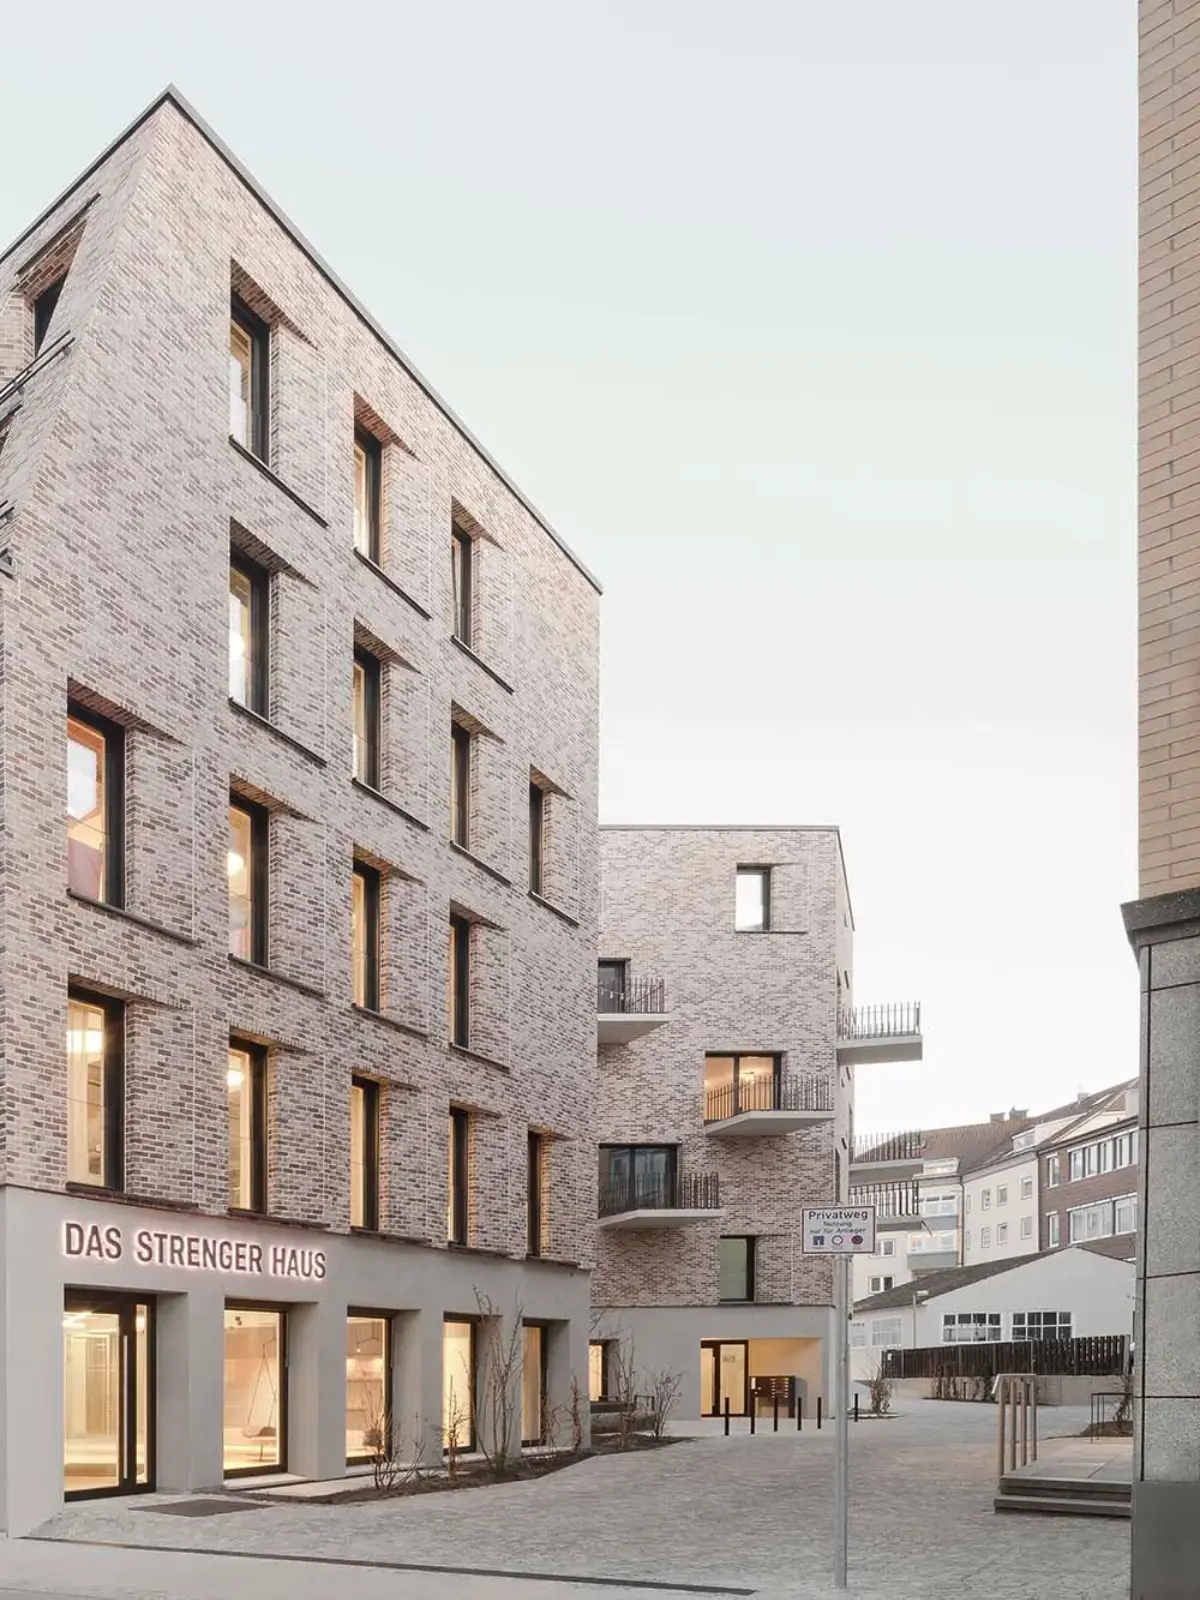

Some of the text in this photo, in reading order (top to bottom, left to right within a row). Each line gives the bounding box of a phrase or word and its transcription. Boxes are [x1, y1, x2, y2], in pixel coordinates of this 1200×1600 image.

[808, 1211, 868, 1221] Privatweg
[65, 1222, 327, 1279] DAS STRENGER HAUS
